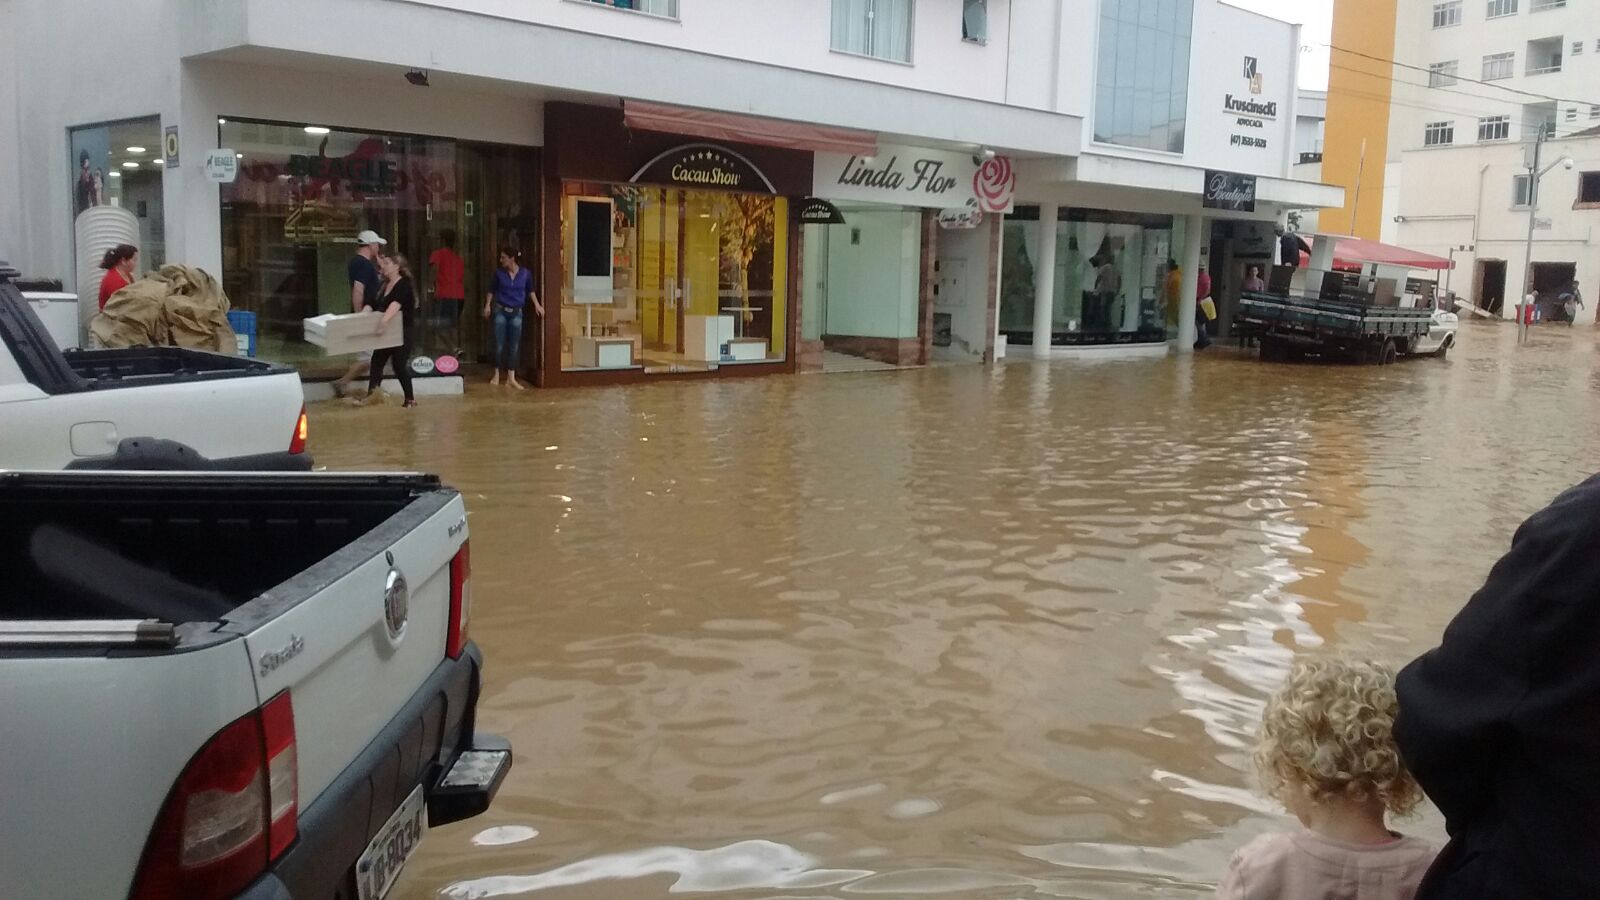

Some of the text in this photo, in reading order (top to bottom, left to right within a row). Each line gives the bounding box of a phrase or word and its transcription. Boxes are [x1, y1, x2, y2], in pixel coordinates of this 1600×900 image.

[1236, 118, 1263, 128] ADVOCACIA
[1230, 134, 1241, 146] (47)
[672, 164, 741, 185] Cacau Show
[838, 155, 957, 194] Linda Flor
